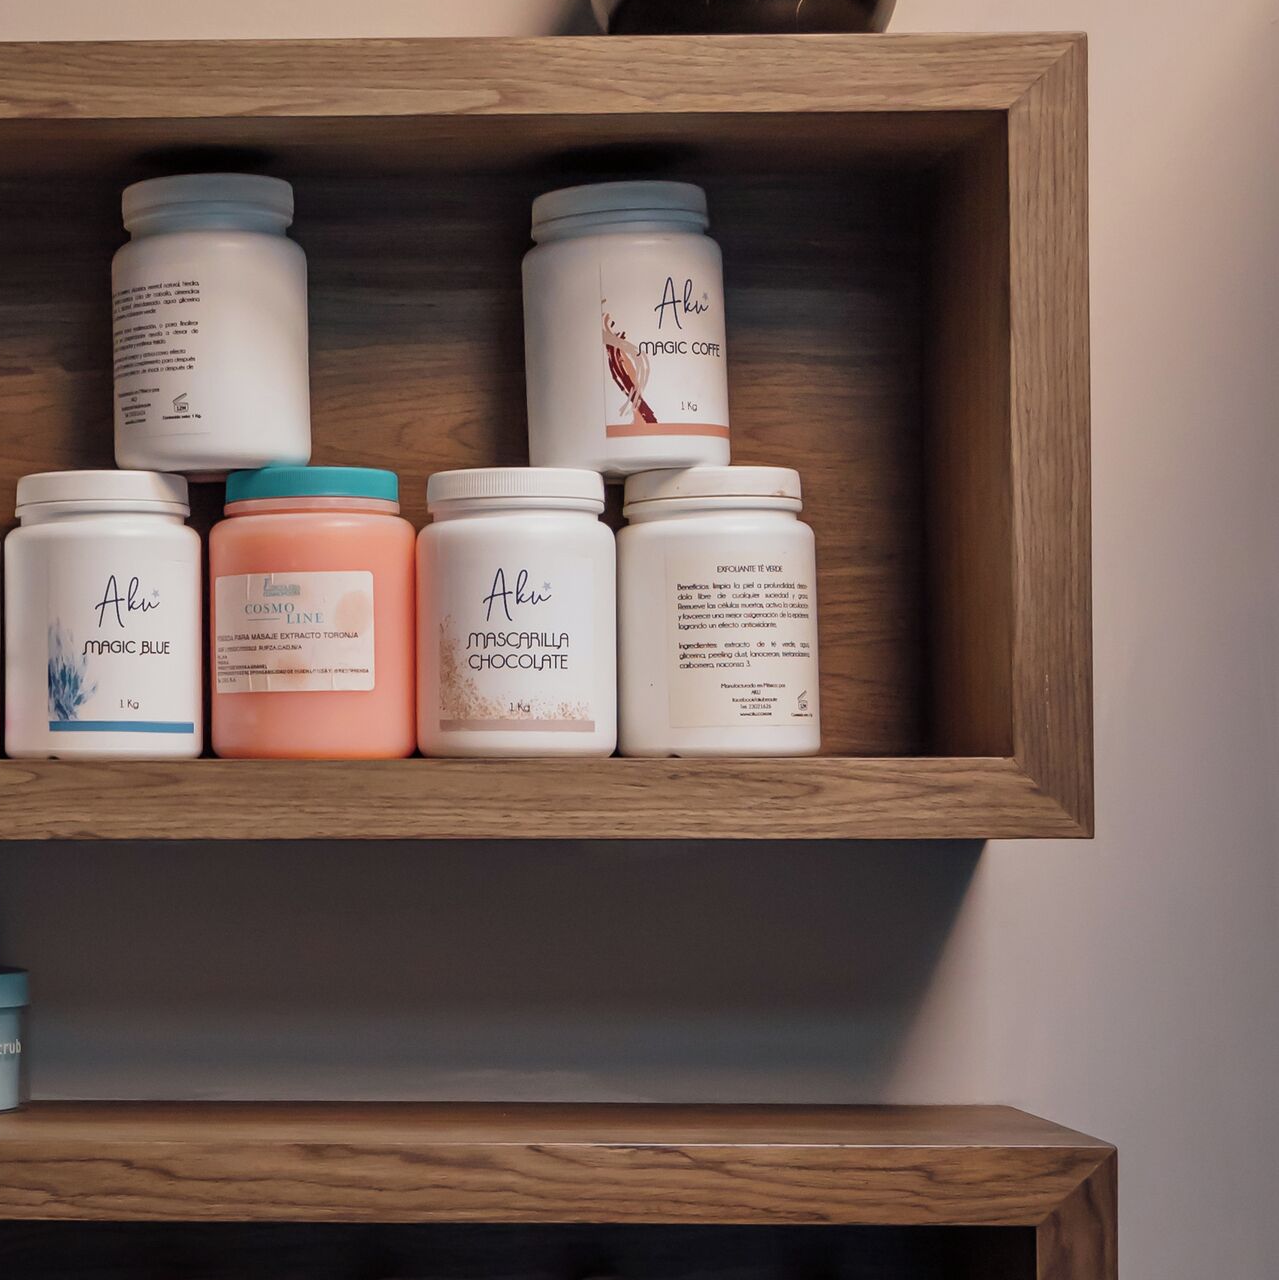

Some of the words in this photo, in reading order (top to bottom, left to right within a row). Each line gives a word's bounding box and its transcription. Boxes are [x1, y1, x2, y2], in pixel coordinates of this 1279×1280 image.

[637, 341, 688, 357] MAGIC
[717, 565, 756, 573] EXFOLIANTE
[766, 565, 783, 573] VERDE
[95, 575, 160, 628] Aku
[483, 568, 552, 621] Aku
[244, 602, 295, 615] COSMO
[287, 613, 325, 625] LINE
[251, 632, 278, 641] MASAJE
[280, 631, 322, 640] EXTRACTO
[324, 631, 359, 639] TORONJA
[466, 632, 569, 650] MASCARILLA
[82, 640, 136, 656] MAGIC
[139, 641, 170, 656] BLUE
[468, 654, 569, 671] CHOCOLATE
[127, 699, 139, 710] Kg
